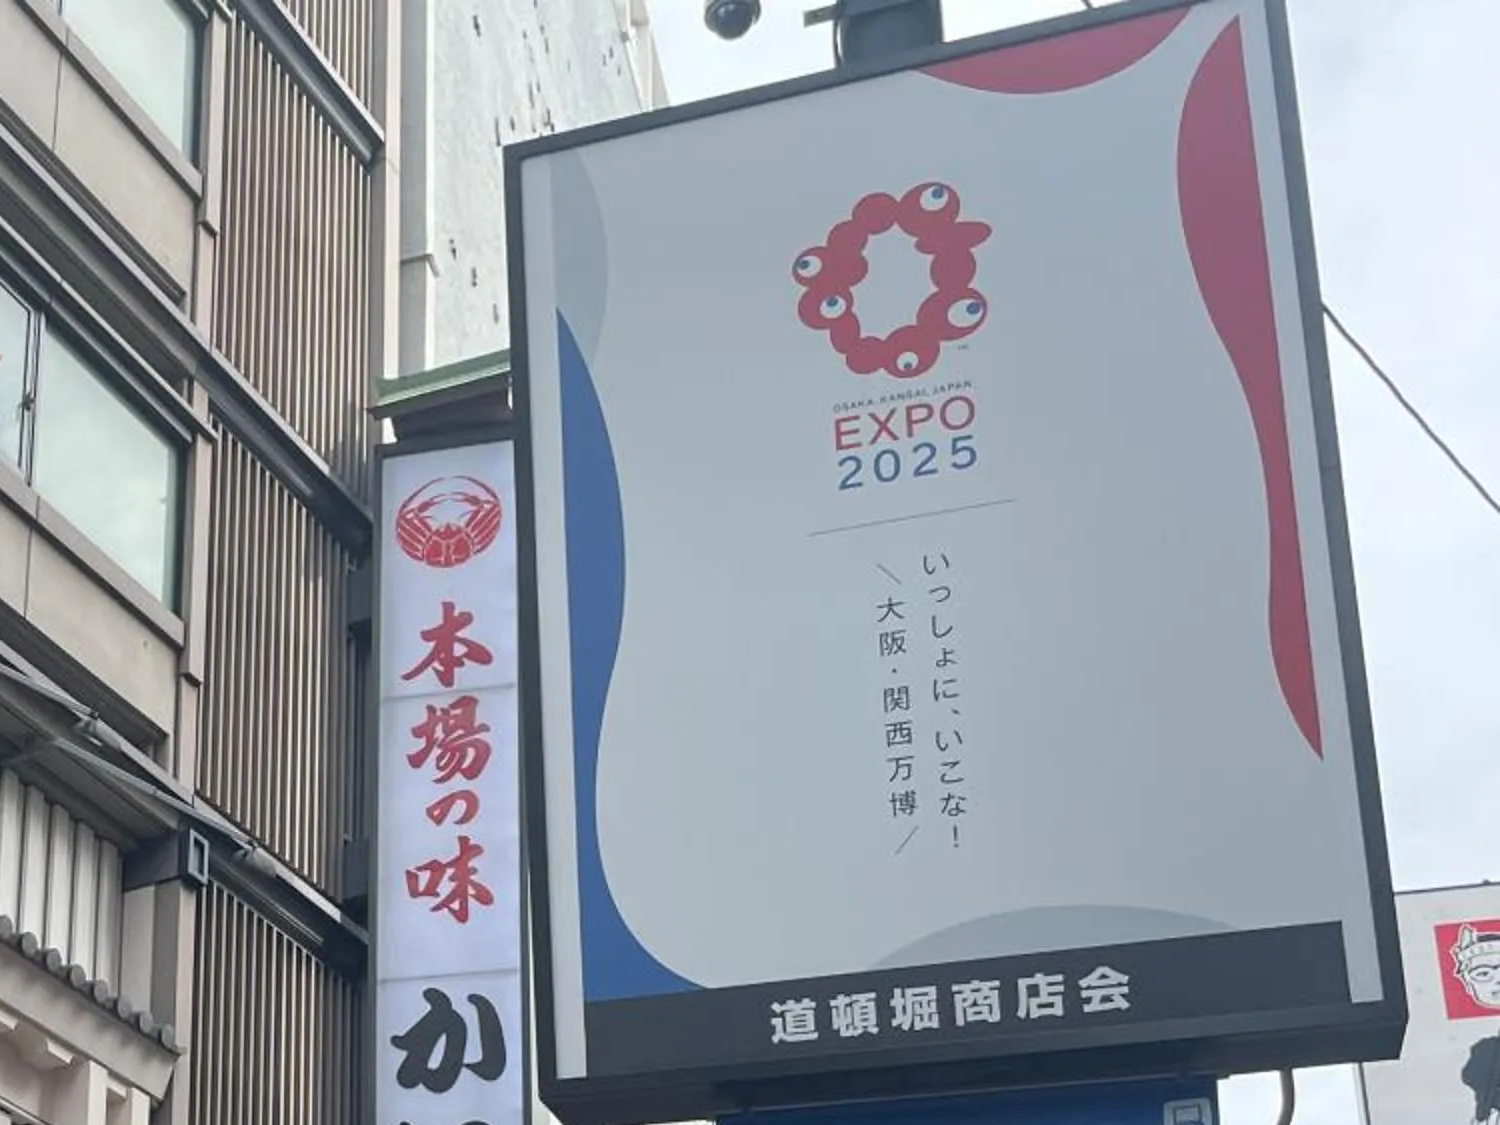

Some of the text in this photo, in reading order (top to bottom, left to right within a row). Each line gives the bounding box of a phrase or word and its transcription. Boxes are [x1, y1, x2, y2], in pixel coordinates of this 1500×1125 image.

[933, 380, 973, 395] JAPAN
[834, 395, 976, 452] EXPO
[837, 435, 978, 491] 2025
[401, 601, 495, 924] 本場の味
[771, 966, 1131, 1044] 道頓堀商店会
